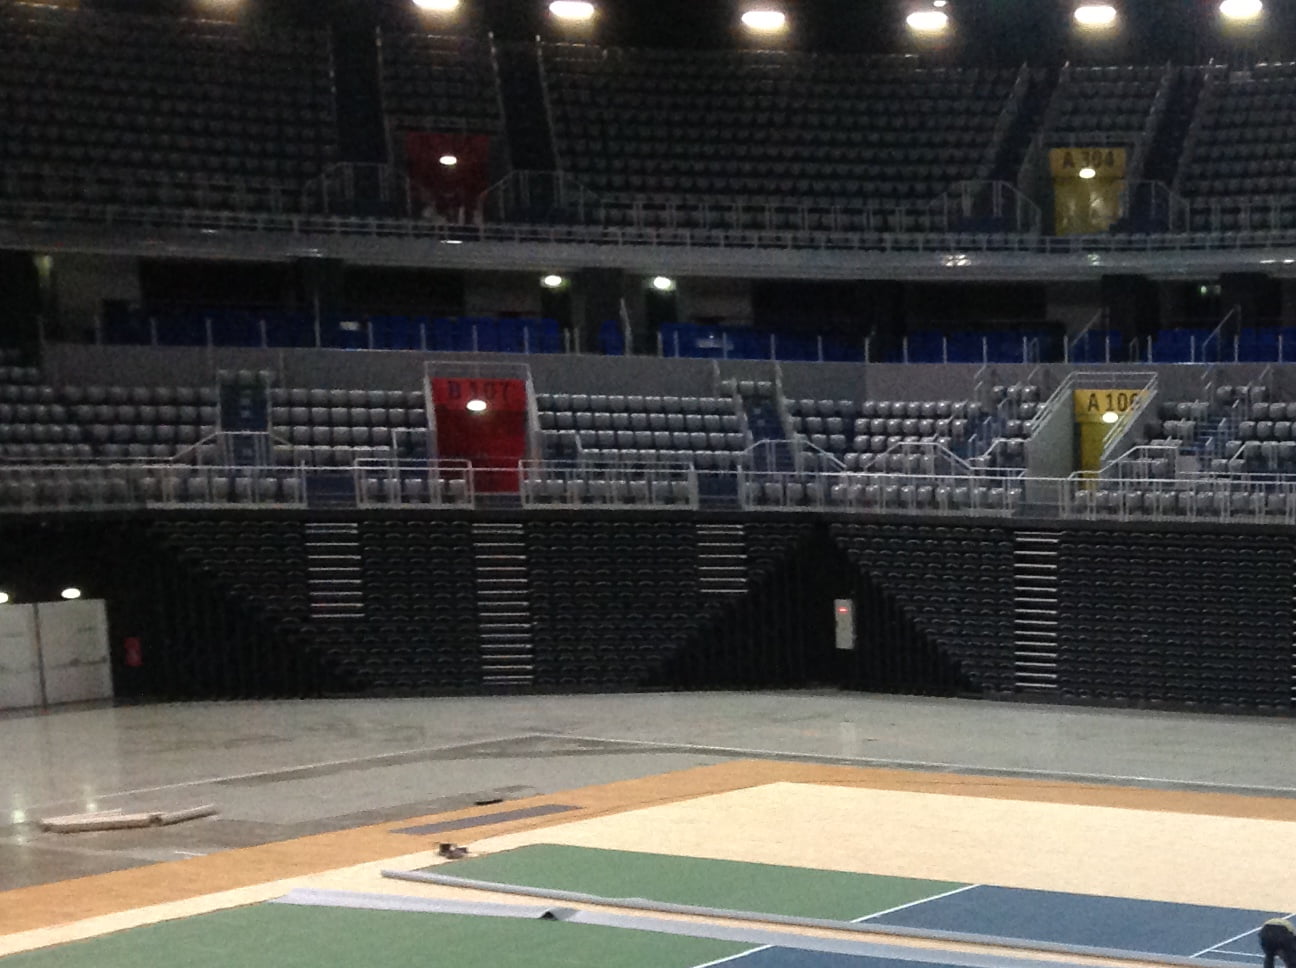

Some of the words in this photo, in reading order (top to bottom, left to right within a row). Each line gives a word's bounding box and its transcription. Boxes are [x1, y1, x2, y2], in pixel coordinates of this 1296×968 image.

[1063, 150, 1075, 169] A
[448, 380, 462, 400] B
[1087, 392, 1100, 413] A
